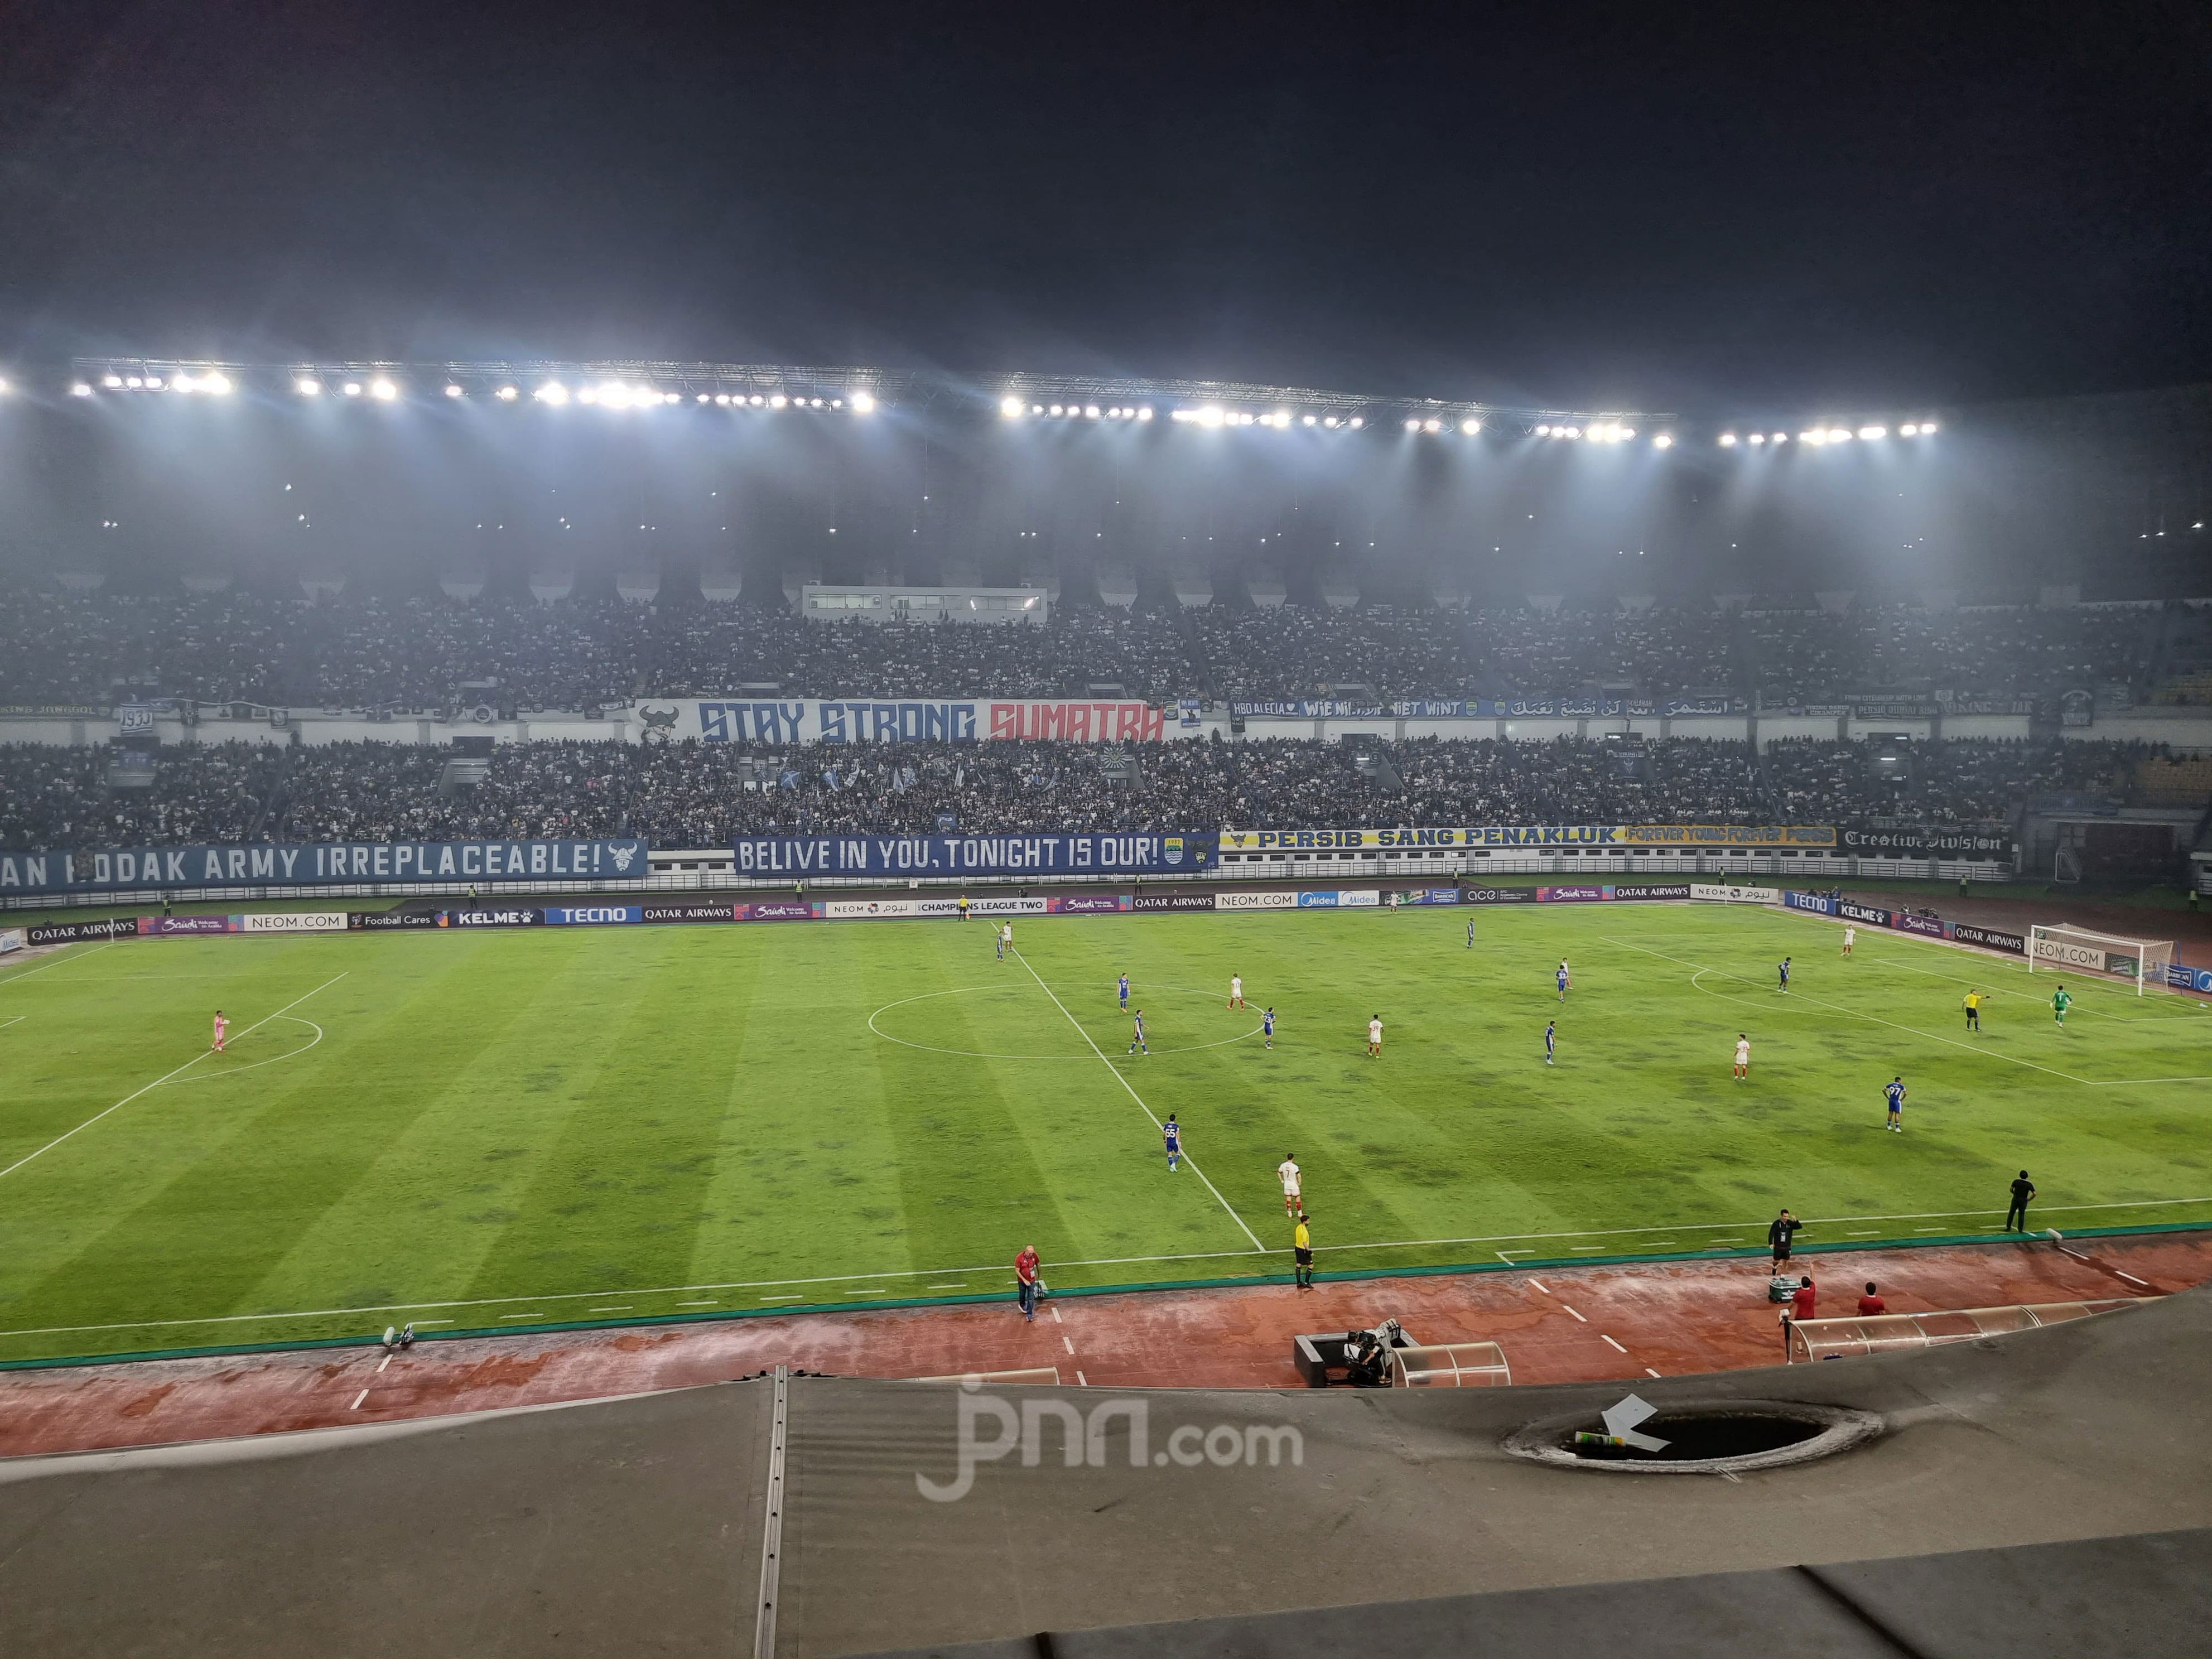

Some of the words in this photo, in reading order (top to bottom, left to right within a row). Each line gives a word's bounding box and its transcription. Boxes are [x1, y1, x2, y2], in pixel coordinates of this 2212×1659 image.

[1234, 703, 1252, 714] HBD
[1254, 703, 1285, 714] ALECIA
[698, 703, 804, 744] STAY
[819, 703, 976, 743] STRONG
[990, 703, 1164, 741] SUMATRA
[1258, 831, 1362, 847] PERSIB
[1378, 829, 1454, 847] SANG
[1465, 827, 1616, 845] PENAKLUK
[1628, 827, 1684, 841] FOREVER
[739, 841, 830, 870] BELIVE
[839, 840, 866, 869] IN
[878, 839, 939, 868] YOU,
[944, 838, 1059, 867] TONIGHT
[1069, 838, 1091, 866] IS
[1101, 837, 1158, 866] OUR!
[1, 857, 47, 886] AN
[204, 848, 299, 880] ARMY
[316, 843, 601, 876] IRREPLACEABLE!
[1468, 890, 1496, 900] ace
[1617, 889, 1646, 897] QATAR
[1650, 887, 1688, 896] AIRWAYS
[1698, 888, 1726, 896] NEOM
[1135, 898, 1168, 908] QATAR
[1172, 897, 1213, 906] AIRWAYS
[1222, 895, 1291, 906] NEOM.COM
[1308, 896, 1336, 905] Midea
[1348, 895, 1376, 904] Midea
[1792, 893, 1828, 912] TECNO
[921, 903, 979, 912] CHAMPINS
[981, 902, 1017, 910] LEAGUE
[1020, 901, 1043, 909] TWO
[459, 912, 519, 924] KELME
[561, 908, 627, 923] TECNO
[645, 909, 682, 919] QATAR
[686, 908, 731, 918] AIRWAYS
[1841, 904, 1876, 922] KELME
[253, 915, 340, 929] NEOM.COM
[365, 915, 401, 925] Football
[404, 915, 430, 924] Cares
[32, 927, 76, 941] QATAR
[82, 921, 135, 935] AIRWAYS
[1956, 927, 1983, 942] QATAR
[1986, 933, 2021, 949] AIRWAYS
[2033, 942, 2098, 966] NEOM.COM
[1890, 1087, 1901, 1096] 97
[1165, 1128, 1175, 1138] 55
[1285, 1169, 1290, 1179] 7
